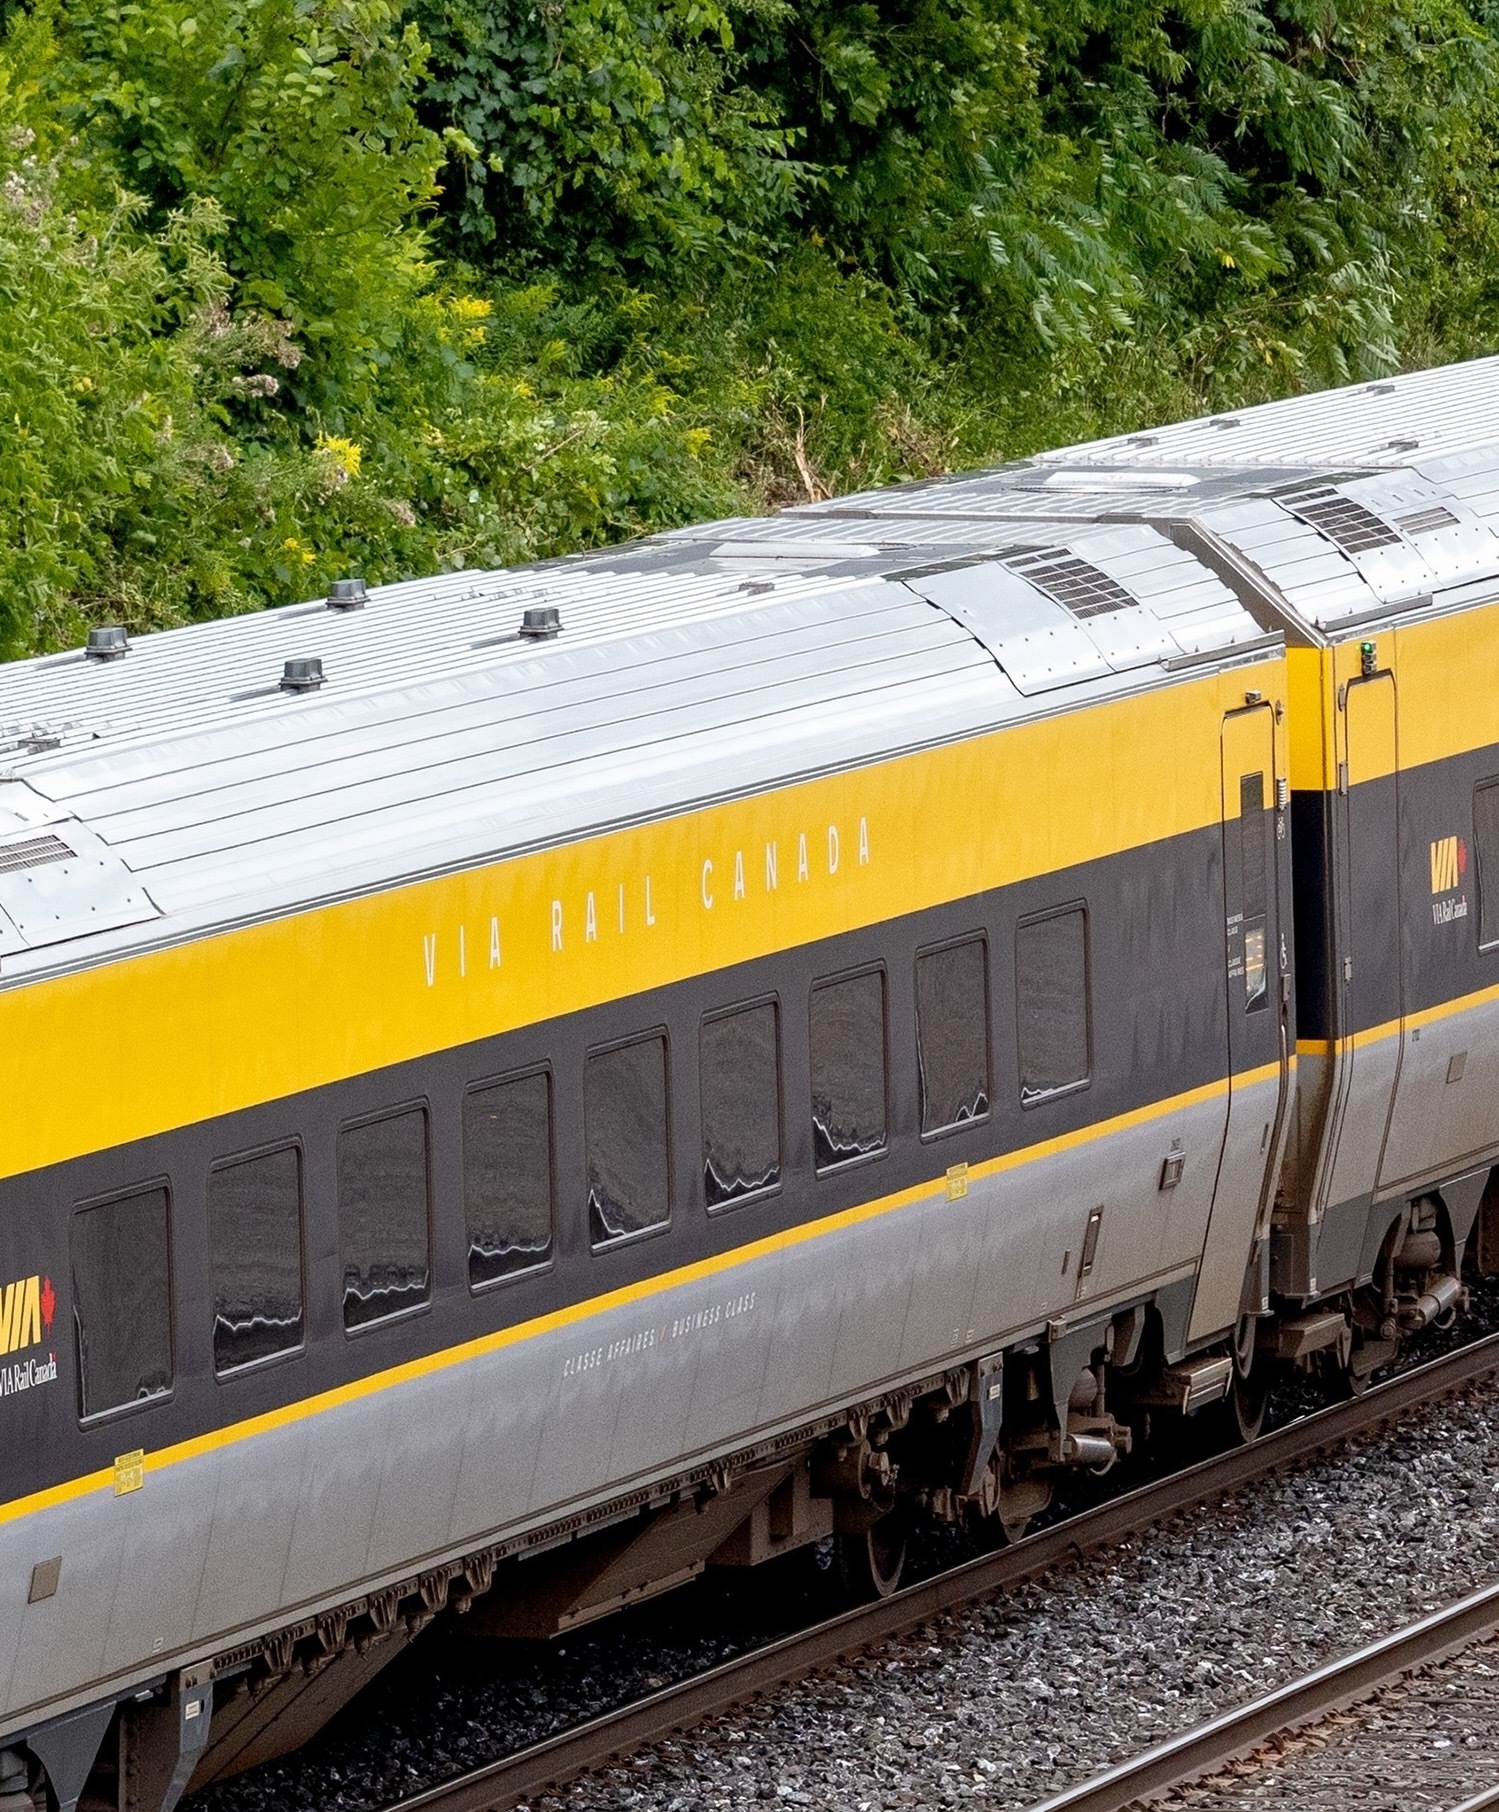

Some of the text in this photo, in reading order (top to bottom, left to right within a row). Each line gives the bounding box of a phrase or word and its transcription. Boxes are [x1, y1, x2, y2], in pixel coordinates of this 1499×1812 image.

[1430, 835, 1458, 894] VIA
[423, 816, 870, 987] VIA RAIL CANADA
[563, 1347, 604, 1377] CLASSE
[606, 1328, 655, 1362] AFFAIRES
[672, 1305, 721, 1338] BUSINESS
[724, 1291, 756, 1319] CLASS
[14, 1360, 30, 1393] Rail
[29, 1352, 58, 1387] Canada
